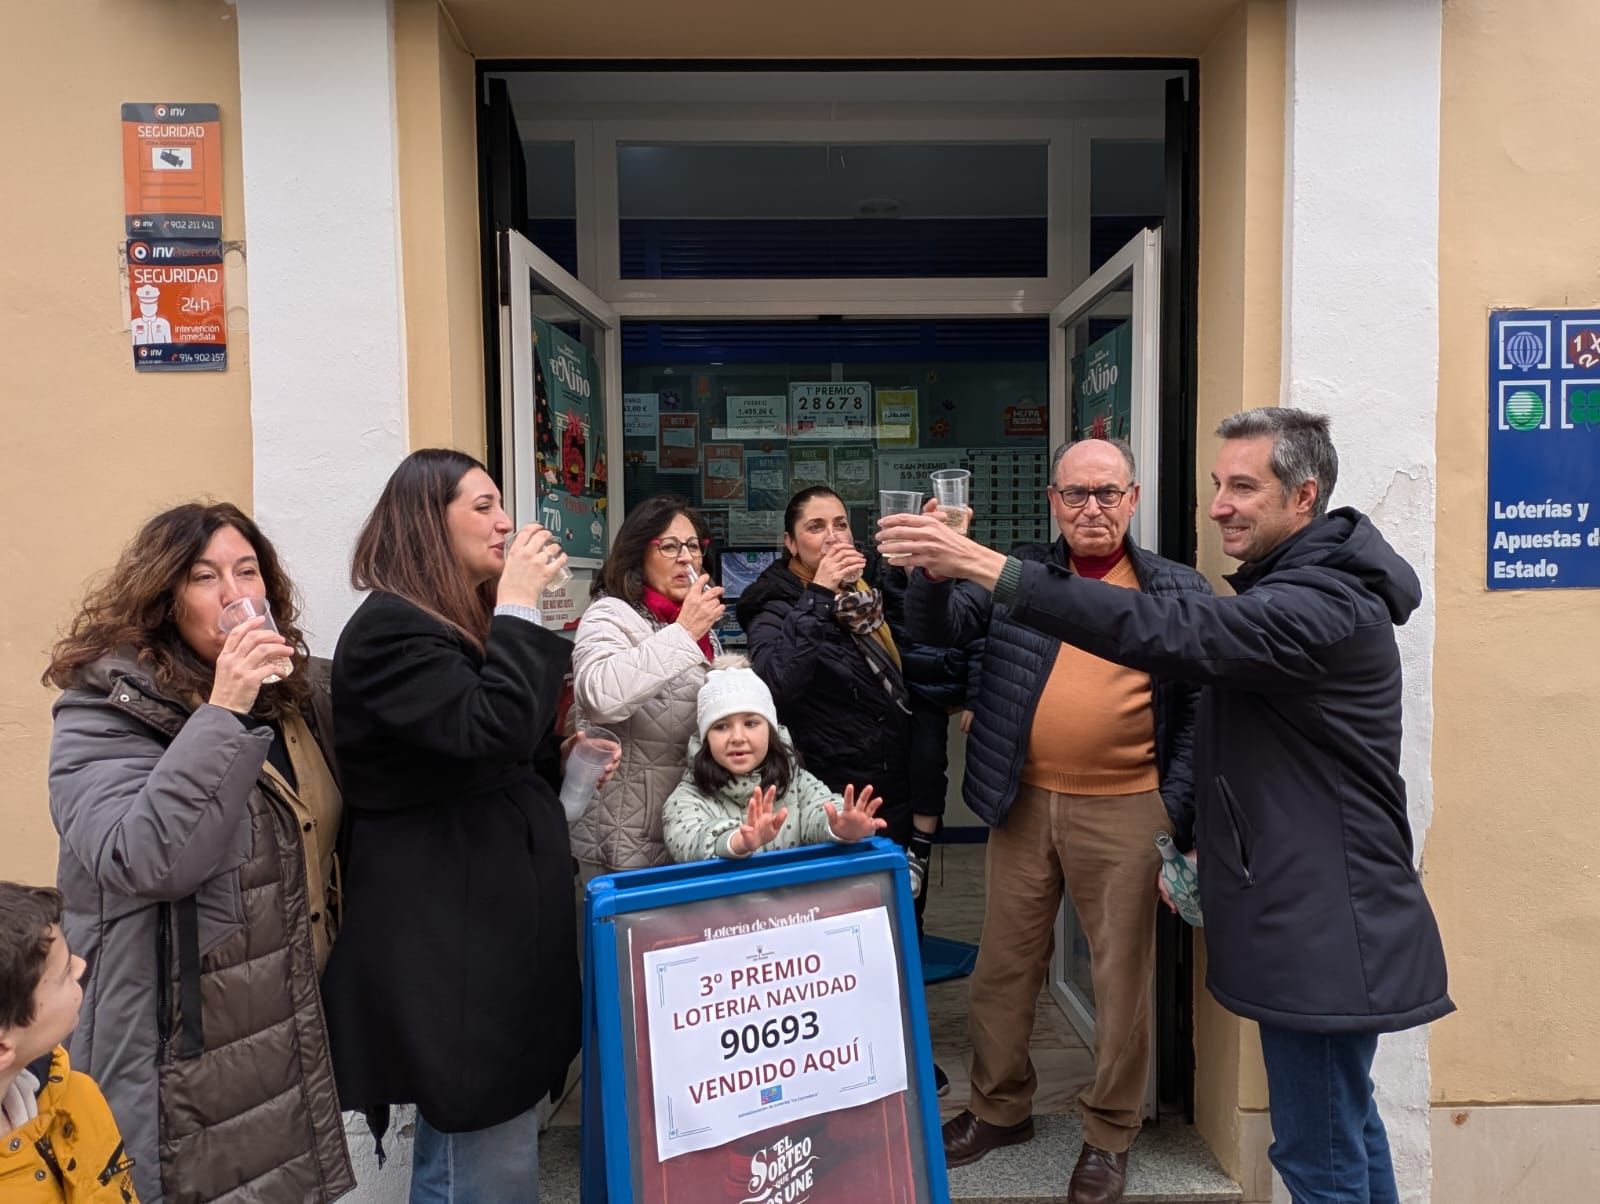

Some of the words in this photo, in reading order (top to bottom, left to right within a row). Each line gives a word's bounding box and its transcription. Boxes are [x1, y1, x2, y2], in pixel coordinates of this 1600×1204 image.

[138, 126, 205, 138] SEGURIDAD
[171, 220, 186, 229] 902
[188, 221, 200, 229] 211
[202, 221, 215, 230] 411
[134, 268, 218, 283] SEGURIDAD
[181, 297, 210, 312] 24h
[180, 332, 216, 341] inmediata
[179, 353, 193, 362] 914
[194, 353, 210, 361] 902
[212, 353, 225, 361] 157
[815, 386, 856, 396] PREMIO
[798, 396, 862, 410] 28678
[917, 462, 947, 470] PREMIO
[542, 506, 561, 532] 770
[1494, 498, 1572, 520] Loterías
[1577, 502, 1590, 522] y
[1493, 529, 1582, 554] Apuestas
[1587, 527, 1600, 547] d
[1494, 558, 1559, 579] Estado
[751, 918, 766, 931] de
[768, 906, 820, 928] Navidad
[700, 972, 723, 997] 3º
[731, 954, 821, 990] PREMIO
[673, 994, 760, 1031] LOTERIA
[767, 974, 857, 1008] NAVIDAD
[720, 1010, 820, 1060] 90693
[689, 1057, 796, 1104] VENDIDO
[803, 1036, 860, 1074] AQUÍ
[773, 1135, 793, 1156] EL
[748, 1136, 812, 1194] SORTEO
[776, 1173, 790, 1189] QUE
[784, 1168, 814, 1202] UNE
